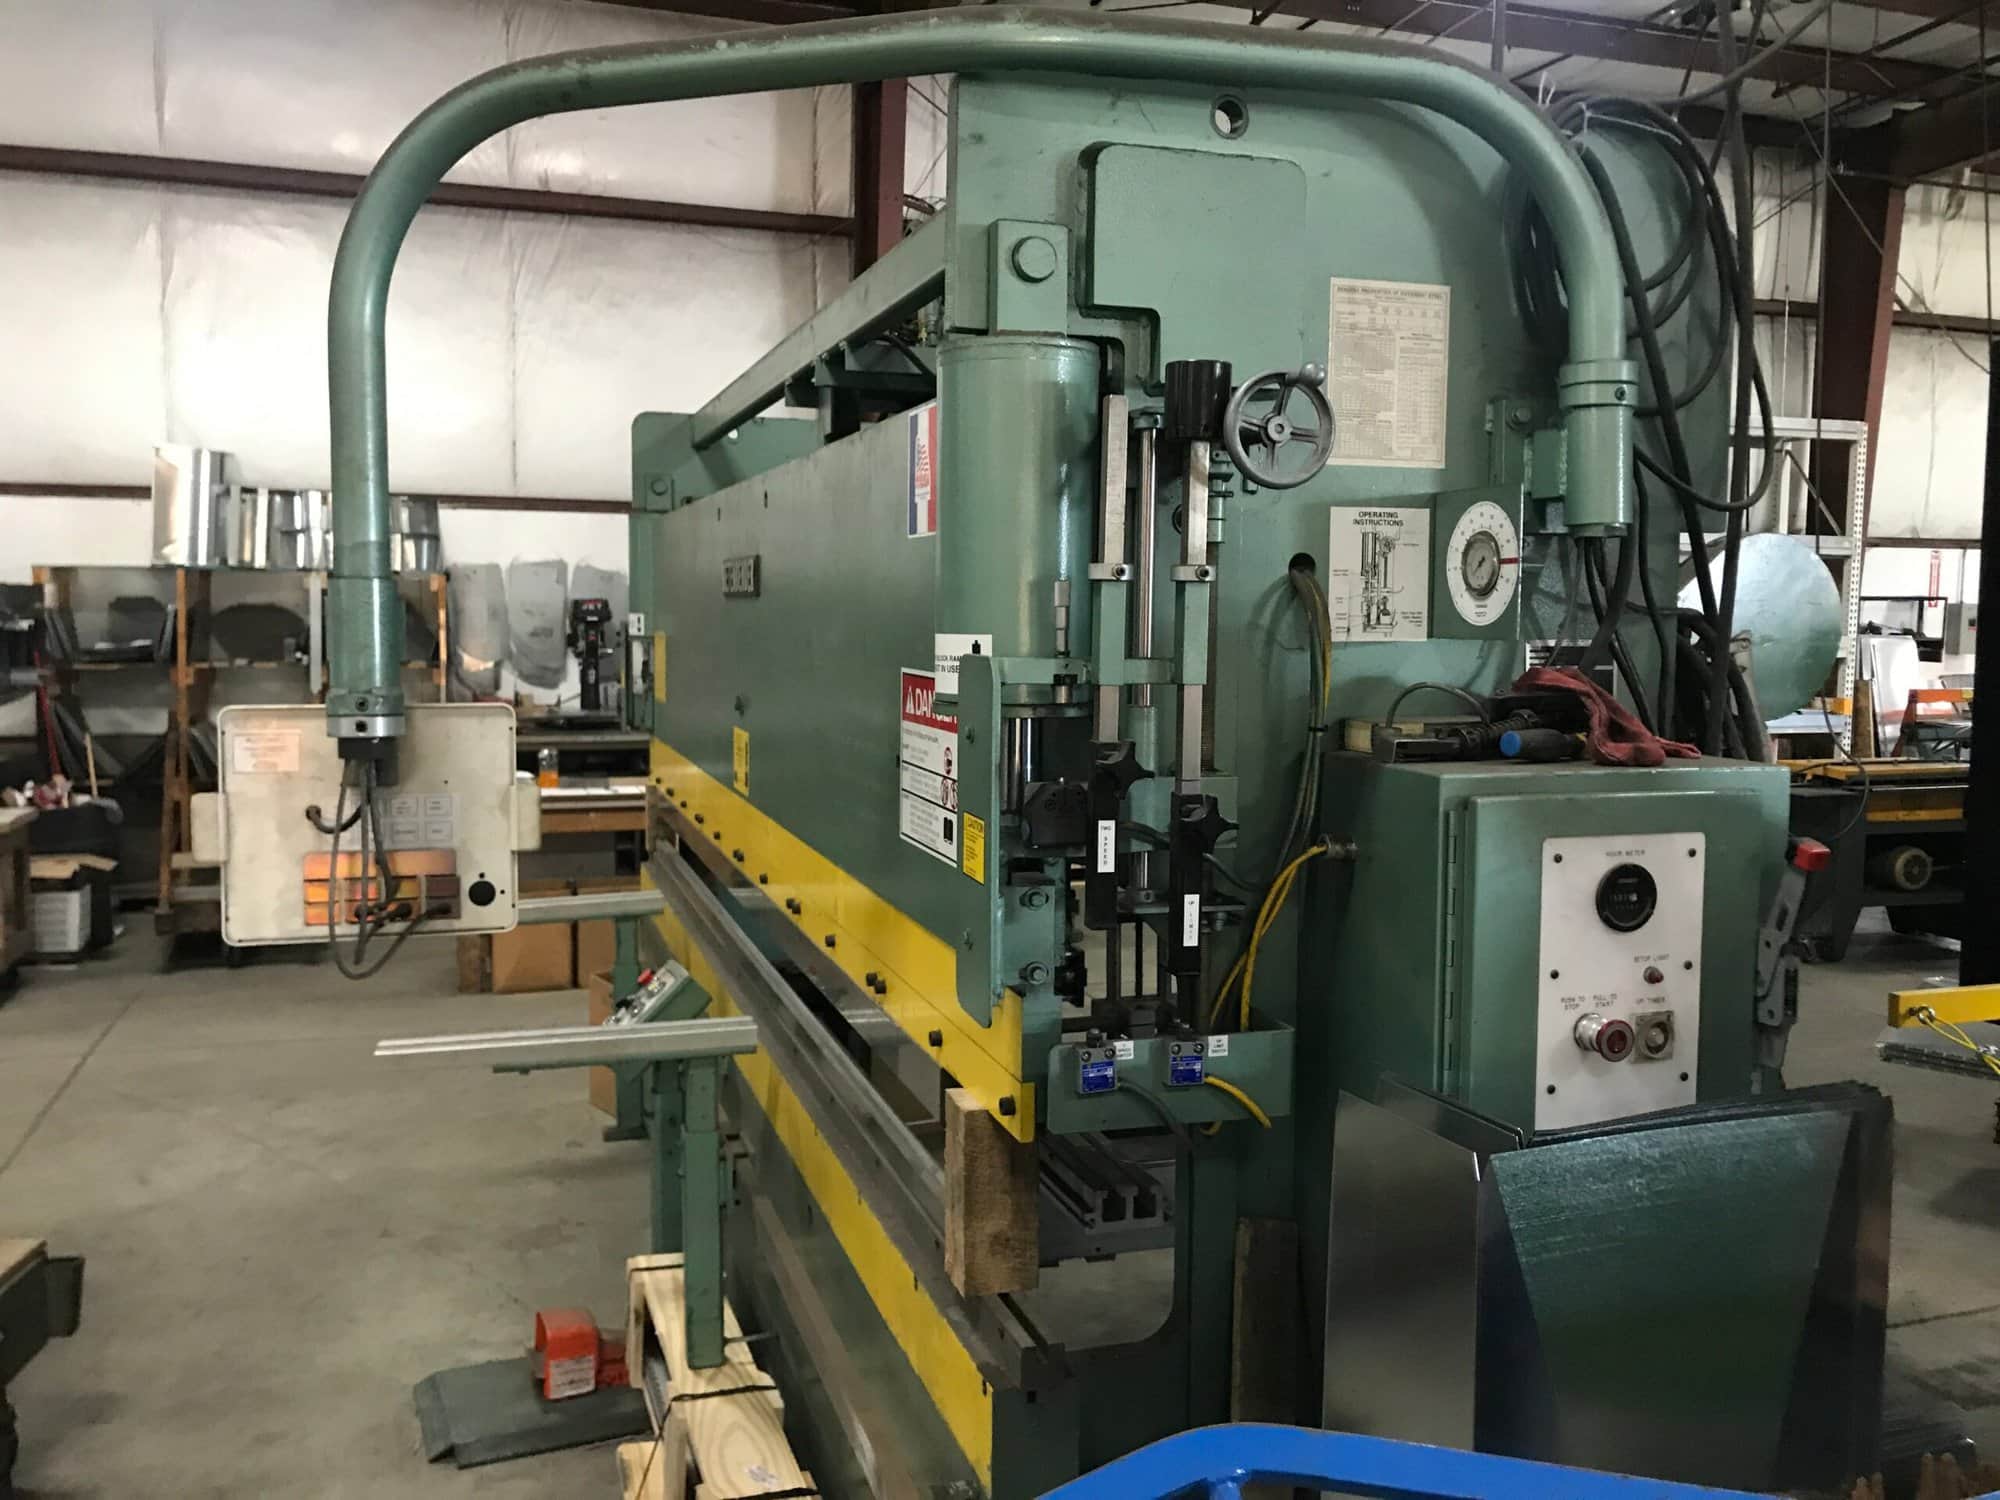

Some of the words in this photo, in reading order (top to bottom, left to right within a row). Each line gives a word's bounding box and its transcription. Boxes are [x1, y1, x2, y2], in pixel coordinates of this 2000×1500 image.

[1352, 519, 1404, 527] INSTRUCTIONS
[1625, 849, 1645, 857] METER
[1564, 1003, 1580, 1011] STOP
[1595, 1000, 1614, 1008] START
